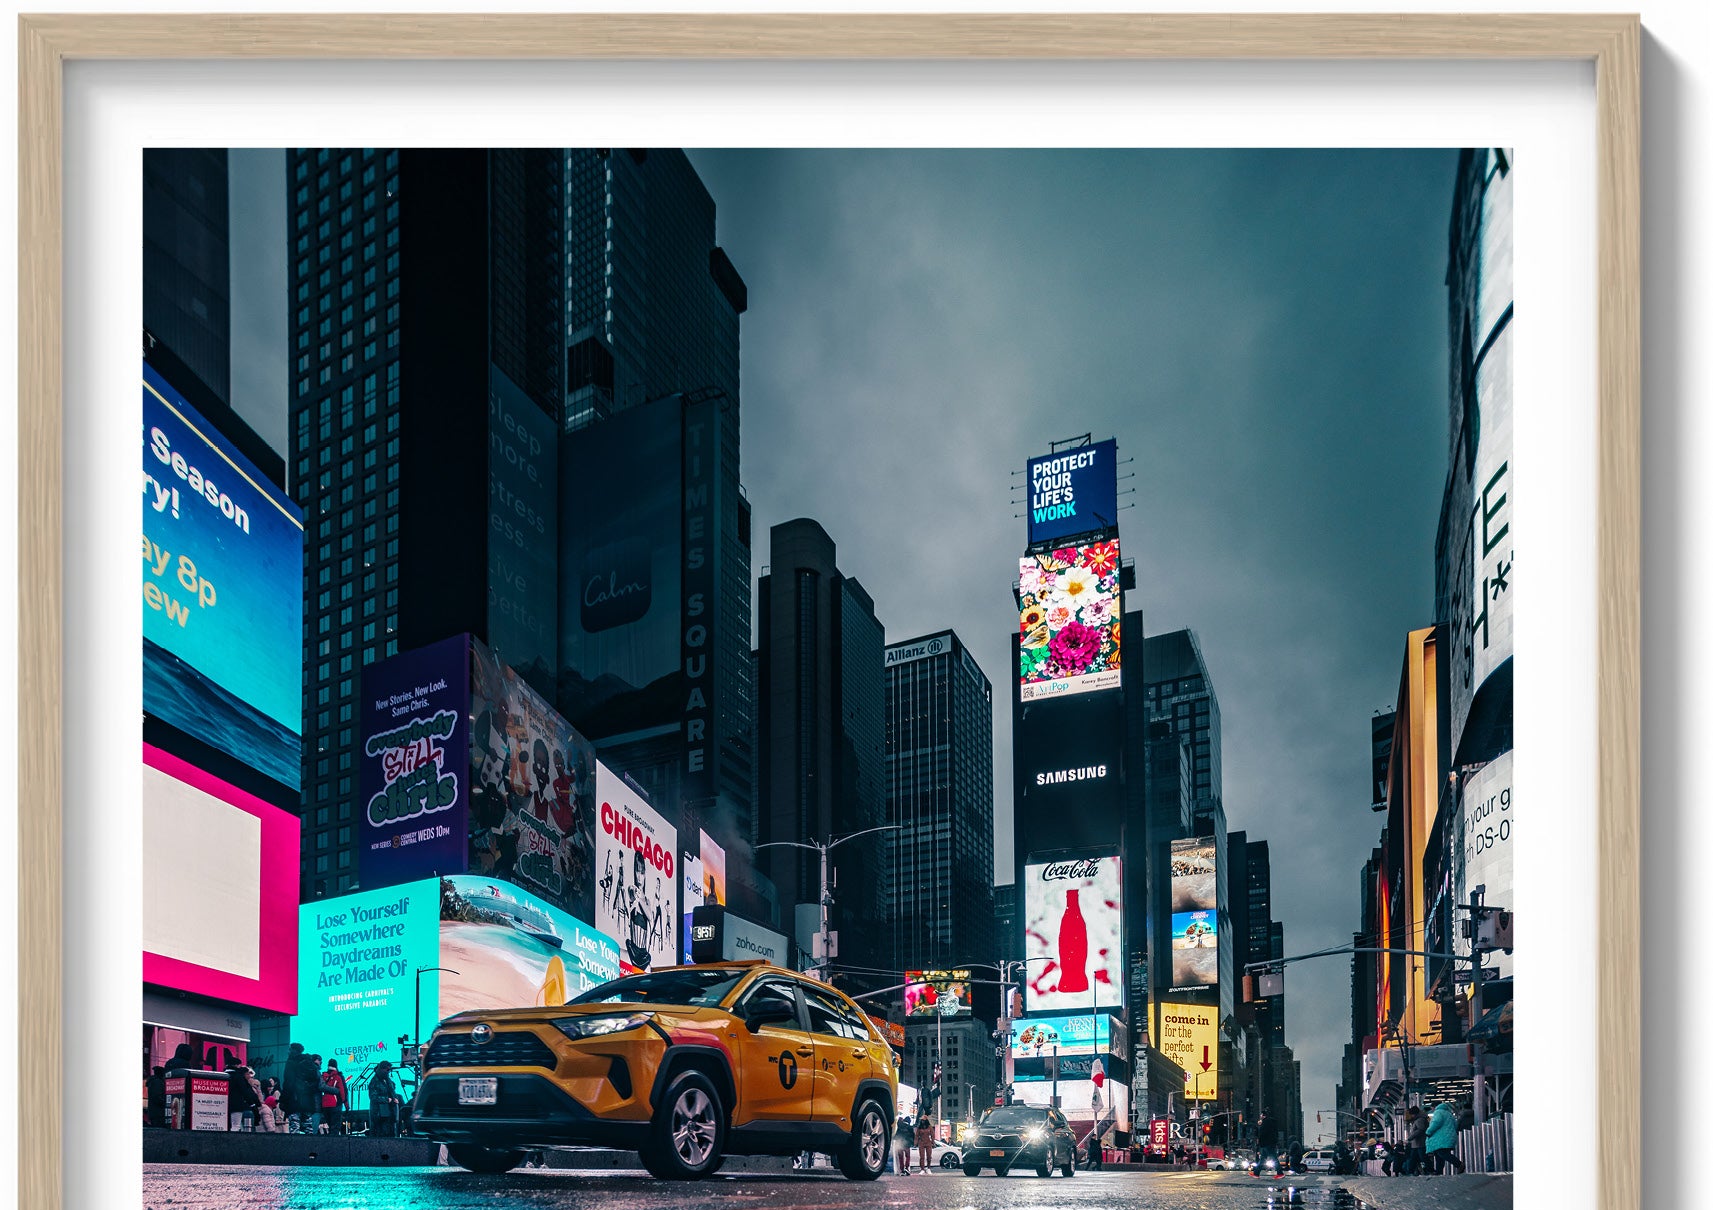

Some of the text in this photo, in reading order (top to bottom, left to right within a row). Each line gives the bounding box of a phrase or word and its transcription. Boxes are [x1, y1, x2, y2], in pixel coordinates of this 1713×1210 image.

[1033, 450, 1096, 479] PROTECT
[151, 426, 250, 535] Season
[1033, 472, 1072, 493] YOUR
[1033, 487, 1073, 509] LIFE'S
[1033, 501, 1076, 524] WORK
[177, 554, 217, 609] 8p
[584, 570, 647, 607] Calm
[887, 646, 926, 664] Allianz
[685, 592, 707, 773] SQUARE
[375, 678, 448, 711] New Stories. New Look.
[391, 699, 430, 718] Same Chris.
[367, 711, 456, 753] everybody
[1036, 765, 1107, 785] SAMSUNG
[1470, 794, 1497, 833] your
[417, 828, 435, 842] WEDS
[601, 802, 674, 879] CHICAGO
[1042, 858, 1101, 881] Coca-Cola
[316, 896, 410, 931] Lose Yourself
[320, 922, 405, 949] Somewhere
[575, 927, 598, 954] Lose
[322, 944, 402, 970] Daydreams
[736, 936, 774, 959] zoho.com
[317, 959, 408, 988] Are Made Of
[328, 991, 363, 1003] INTRODUCING
[334, 1002, 361, 1012] EXCLUSIVE
[1164, 1014, 1209, 1026] come in
[1164, 1025, 1192, 1038] for the
[334, 1042, 388, 1056] CELEBRATION
[1164, 1039, 1195, 1054] perfect
[352, 1053, 369, 1064] KEY
[1168, 1053, 1184, 1066] ifts
[1155, 1121, 1167, 1143] tkts
